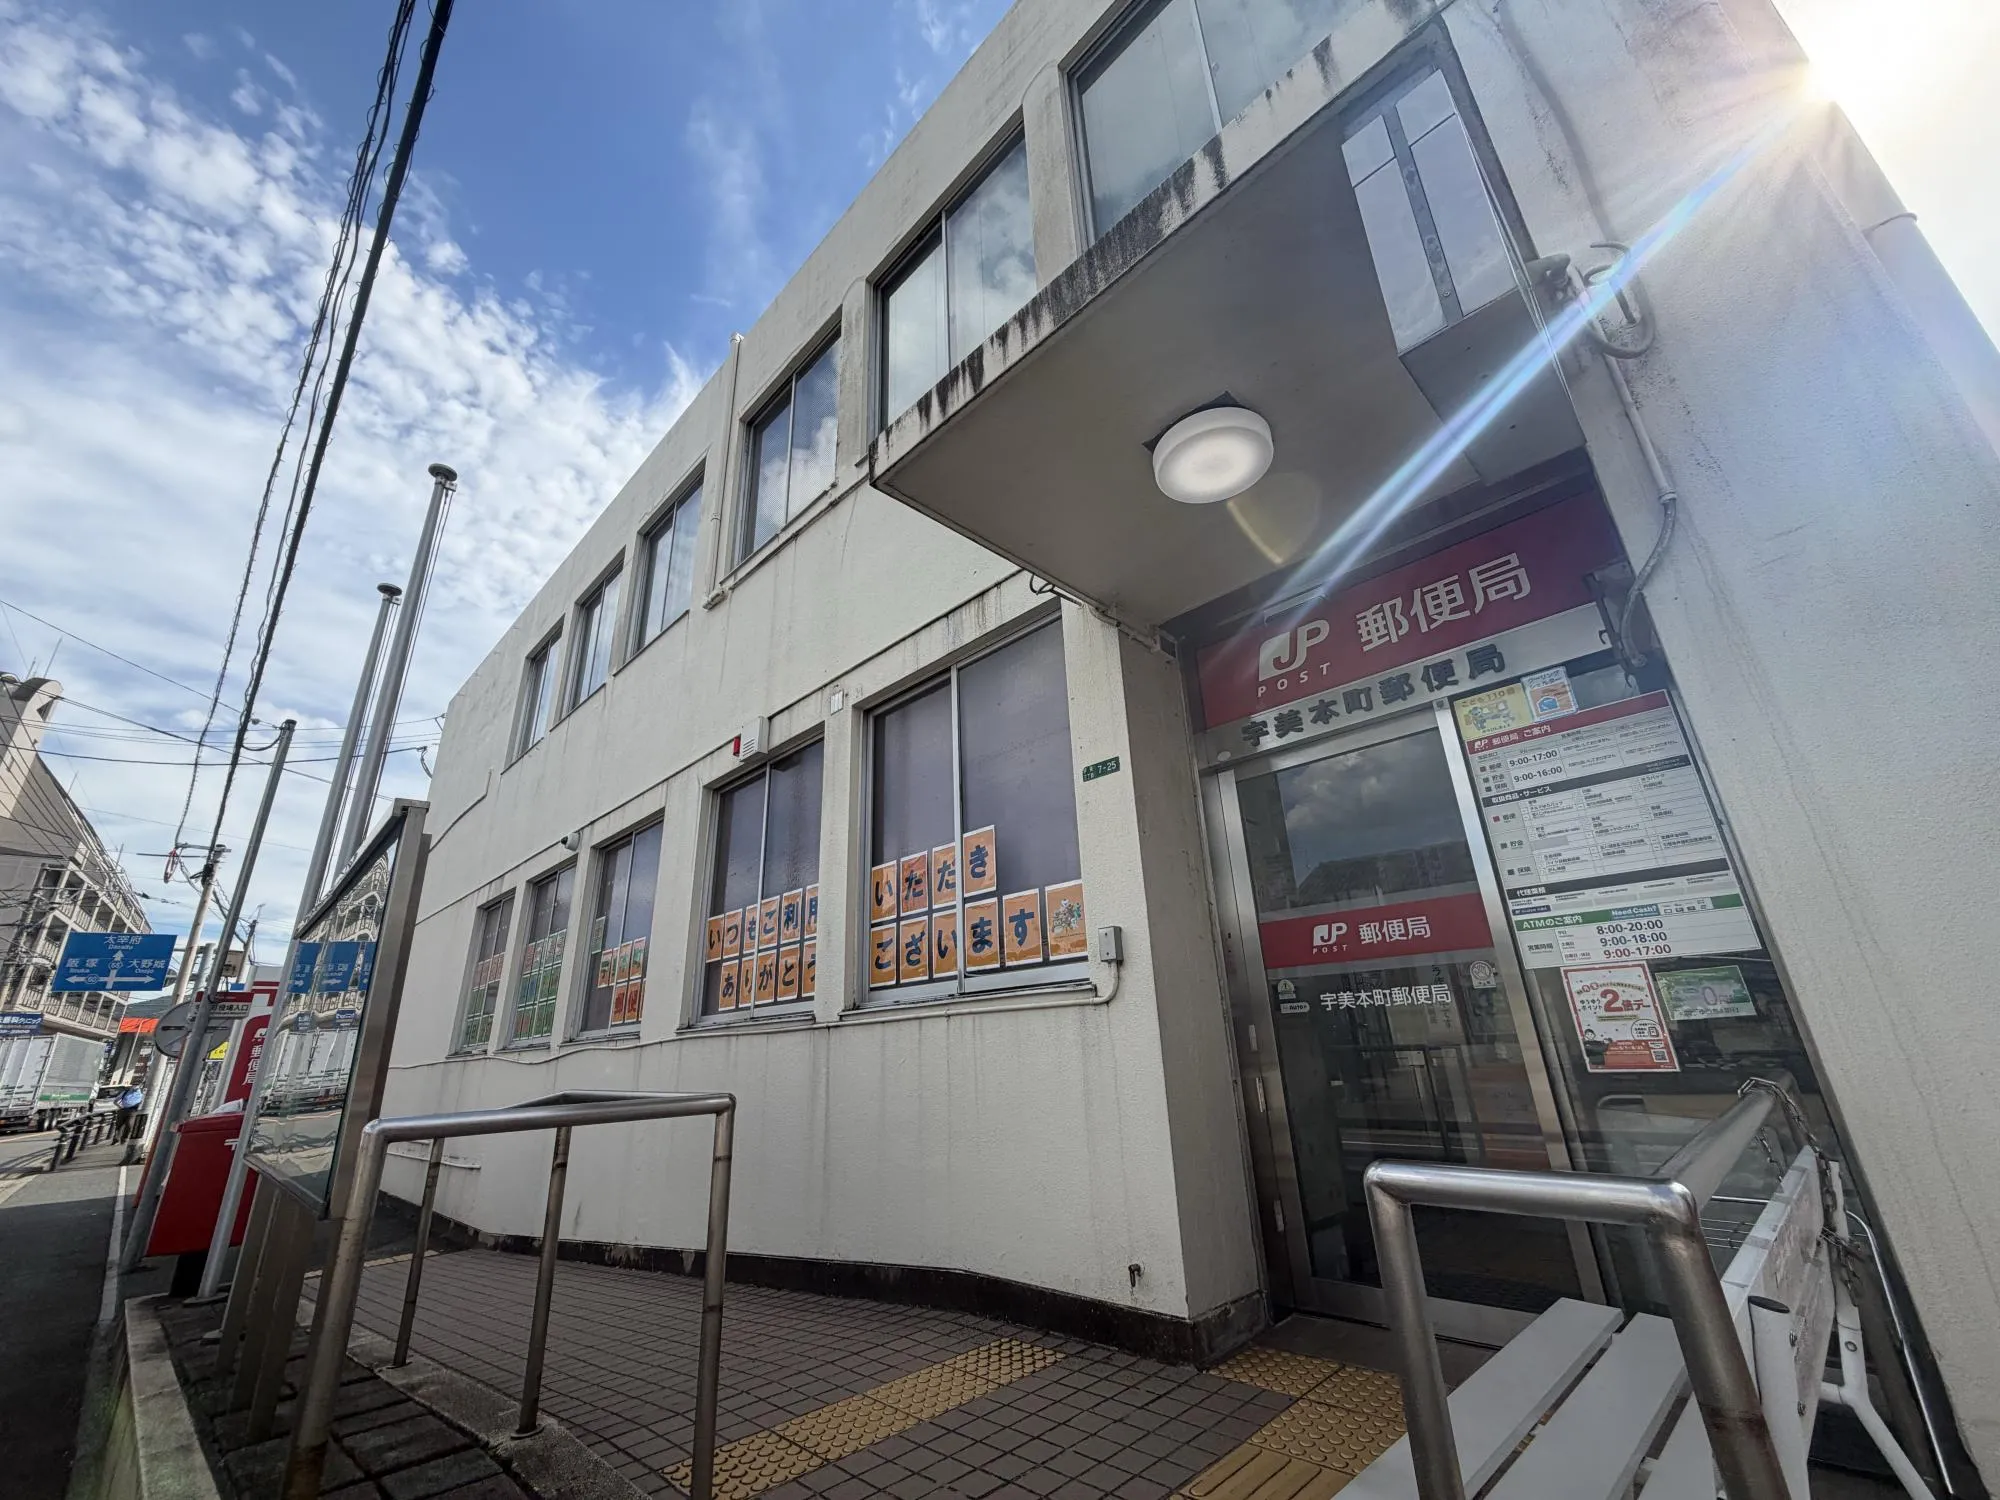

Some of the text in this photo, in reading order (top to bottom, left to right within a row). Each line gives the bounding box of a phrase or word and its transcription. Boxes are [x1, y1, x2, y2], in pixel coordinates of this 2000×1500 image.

[1355, 552, 1532, 653] 郵便局
[1256, 662, 1332, 698] POST
[1240, 643, 1506, 748] 宇美本町郵便局
[1492, 732, 1519, 745] 郵便局
[1523, 724, 1552, 738] ご案内
[1097, 760, 1117, 774] 7-25
[1508, 750, 1558, 767] 9:00-17:00
[1513, 766, 1563, 783] 9:00-16:00
[875, 844, 989, 907] いただき
[1611, 904, 1659, 917] Need Cash?
[1357, 915, 1432, 945] 郵便局
[1522, 914, 1583, 930] ATMのご案内
[1596, 919, 1664, 935] 8:00-20:00
[104, 935, 143, 945] 太宰府
[875, 908, 1035, 971] ございます
[1599, 931, 1668, 947] 9:00-18:00
[1312, 944, 1349, 954] POST
[1603, 944, 1672, 959] 9:00-17:00
[127, 959, 166, 969] 大野城
[1319, 983, 1452, 1012] 宇美本町郵便局
